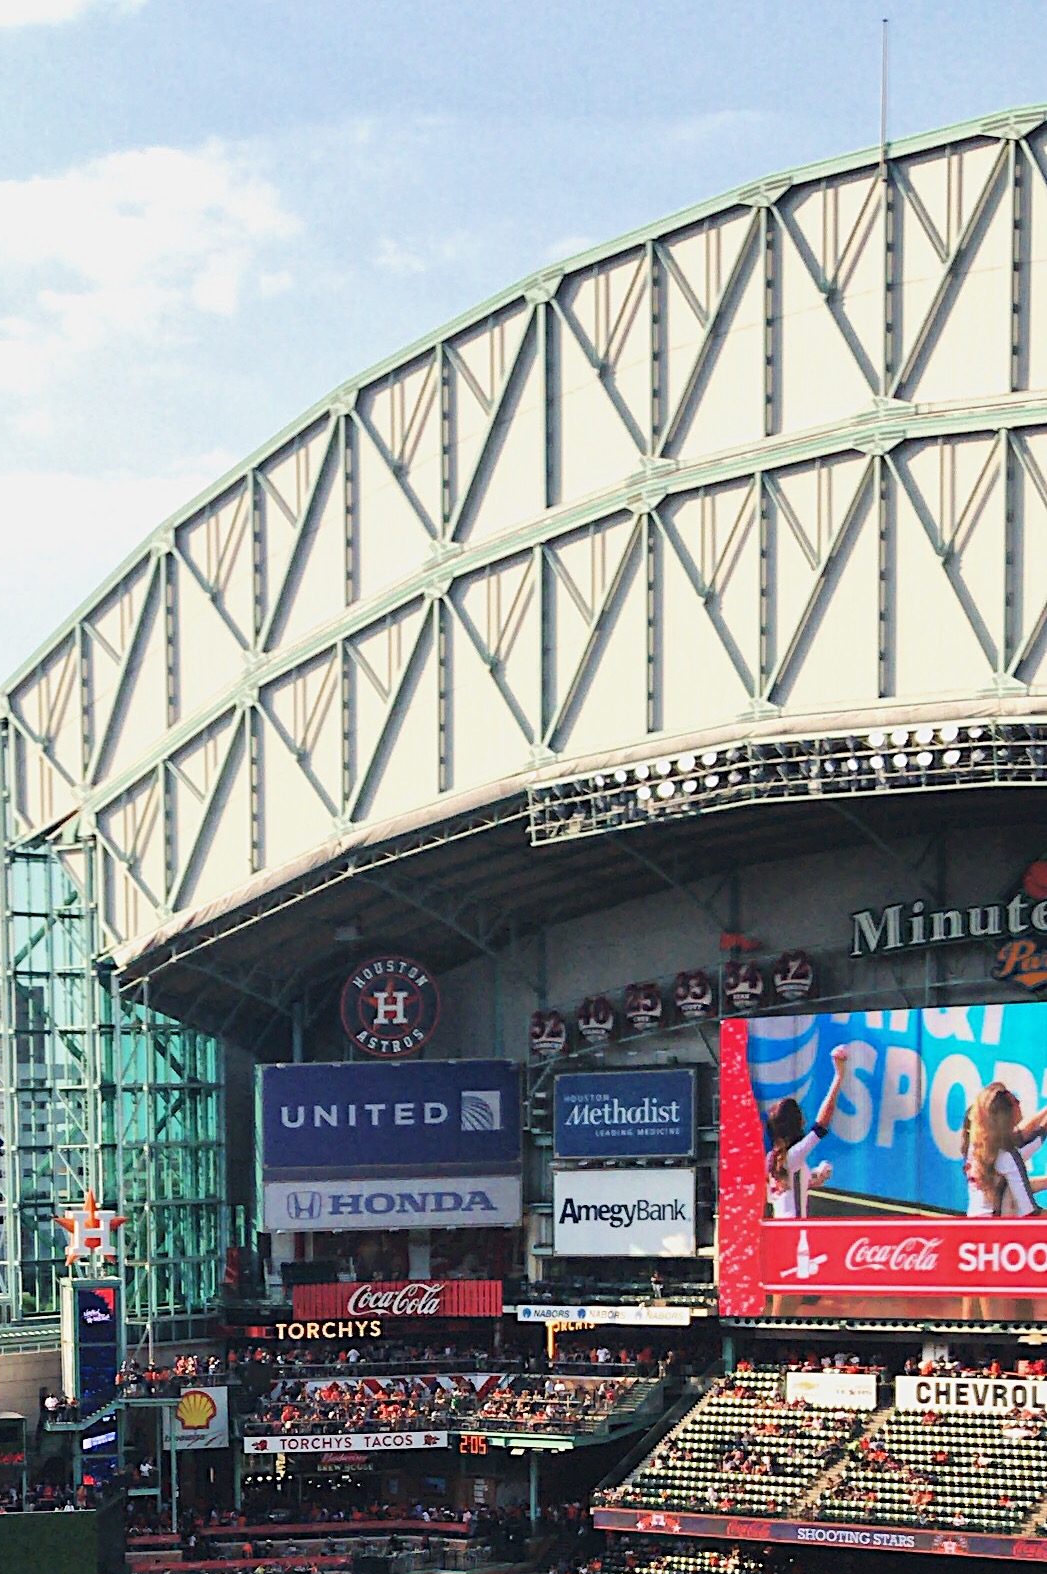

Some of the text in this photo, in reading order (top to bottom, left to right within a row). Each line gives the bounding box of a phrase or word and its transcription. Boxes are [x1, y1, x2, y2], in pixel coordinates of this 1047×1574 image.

[352, 960, 429, 989] HOUSTON
[373, 991, 408, 1025] H
[356, 1028, 425, 1053] ASTROS
[280, 1102, 449, 1129] UNITED
[565, 1097, 680, 1126] Methodist
[328, 1191, 498, 1215] HONDA
[559, 1198, 686, 1228] AmegyBank
[845, 1237, 945, 1271] Coca-Cola
[347, 1283, 445, 1316] Coca-Cola
[534, 1310, 570, 1319] NABORS
[590, 1311, 626, 1320] NABORS
[275, 1320, 382, 1340] TORCHYS
[280, 1435, 413, 1450] TORCHYS TACOS
[797, 1528, 870, 1545] SHOOTING
[873, 1533, 915, 1547] STARS
